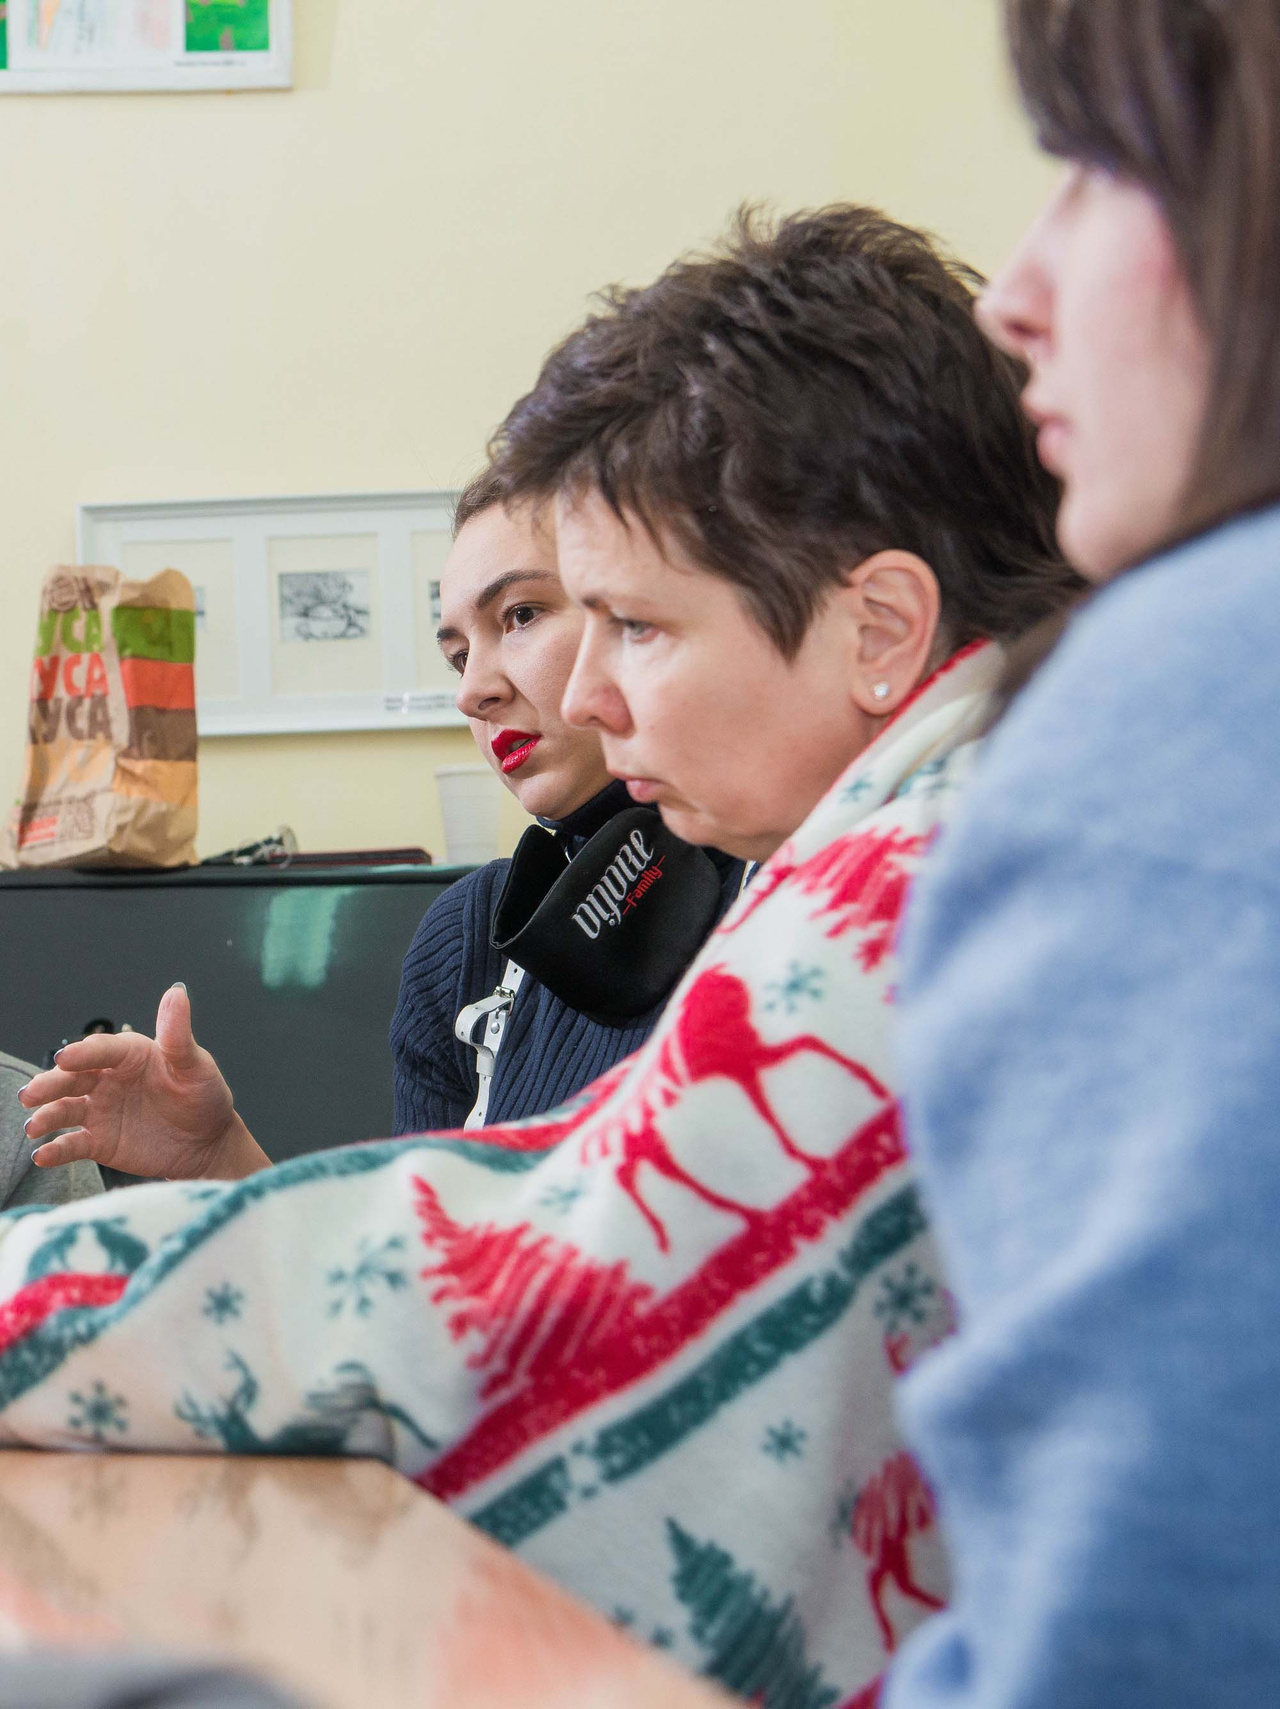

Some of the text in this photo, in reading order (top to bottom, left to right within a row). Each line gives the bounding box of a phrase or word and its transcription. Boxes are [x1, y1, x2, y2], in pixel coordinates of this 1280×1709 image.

[35, 608, 103, 656] УСА
[30, 652, 109, 699] УСА
[625, 865, 663, 908] Family
